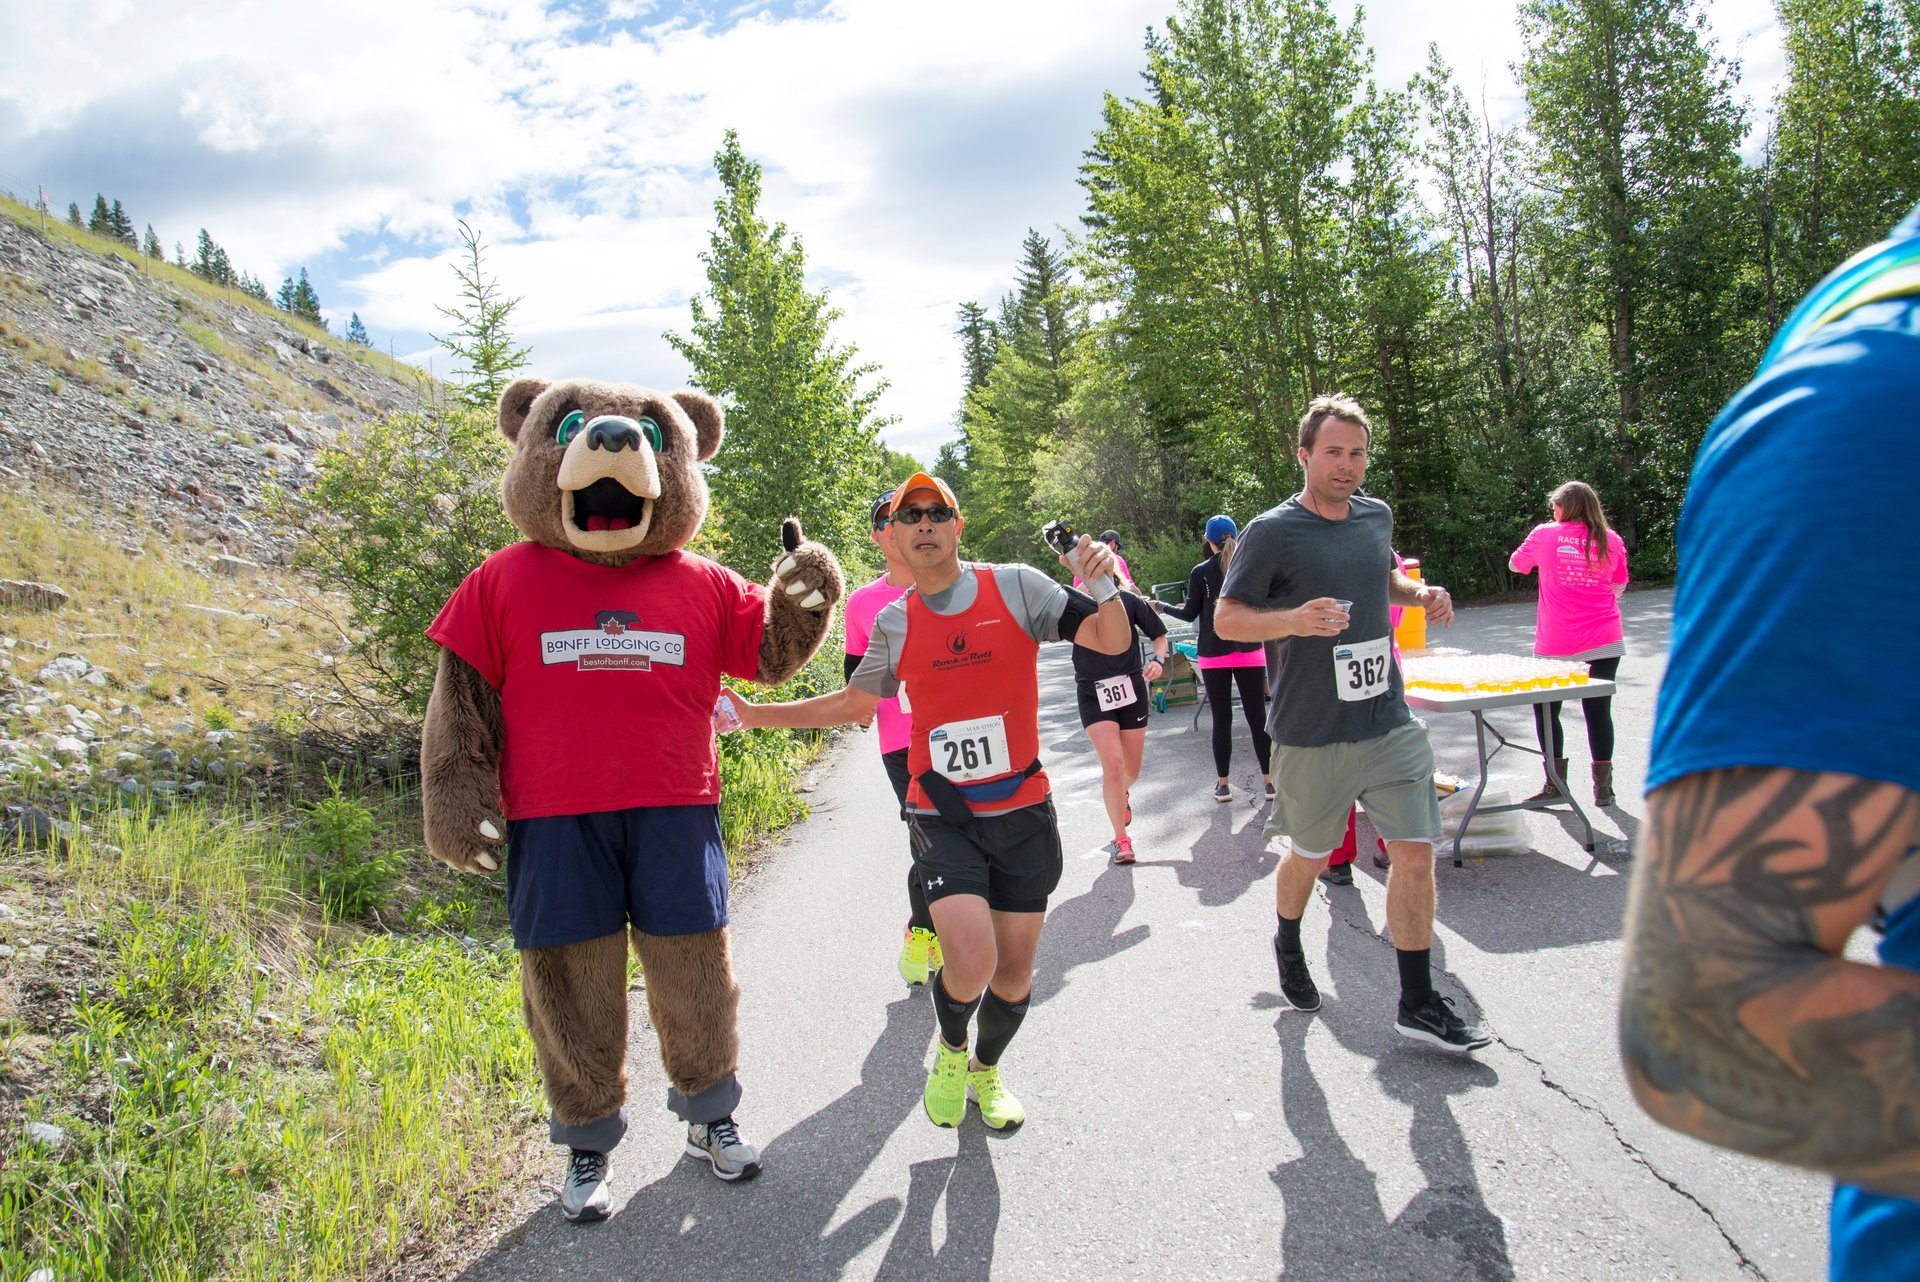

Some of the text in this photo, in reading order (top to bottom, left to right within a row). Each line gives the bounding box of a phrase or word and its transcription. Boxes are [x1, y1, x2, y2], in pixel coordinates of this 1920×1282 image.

[1558, 536, 1580, 545] RACE
[664, 642, 682, 655] Co
[583, 657, 647, 667] bestofbanff.com
[931, 657, 959, 668] Rock
[969, 650, 992, 661] Roll
[937, 662, 970, 672] MARATHON
[1347, 655, 1385, 689] 362
[1103, 683, 1128, 704] 361
[966, 721, 1001, 733] MARATHON
[943, 736, 992, 773] 261
